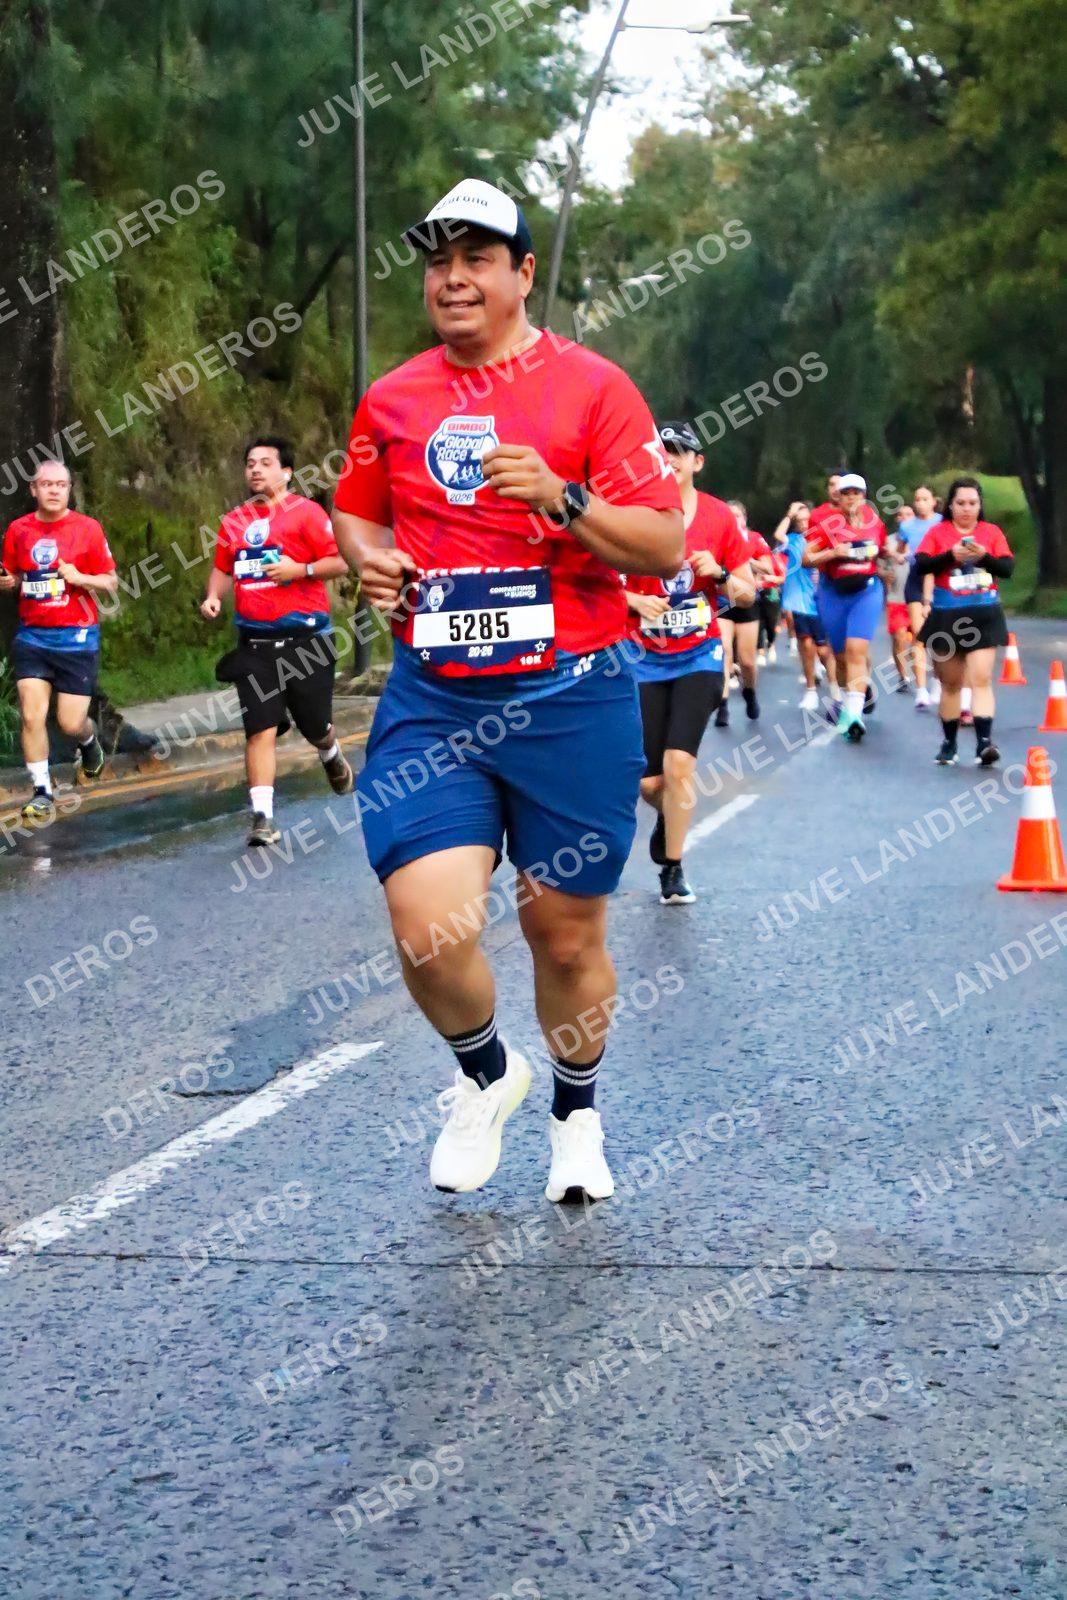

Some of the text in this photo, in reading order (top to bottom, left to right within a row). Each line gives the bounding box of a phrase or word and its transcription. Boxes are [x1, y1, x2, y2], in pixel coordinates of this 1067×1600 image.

[447, 423, 487, 432] BIMBO
[444, 435, 485, 449] Global
[436, 446, 468, 461] Race
[449, 493, 473, 502] 2026
[662, 611, 692, 626] 4975
[449, 611, 510, 642] 5285
[519, 655, 542, 666] 10K
